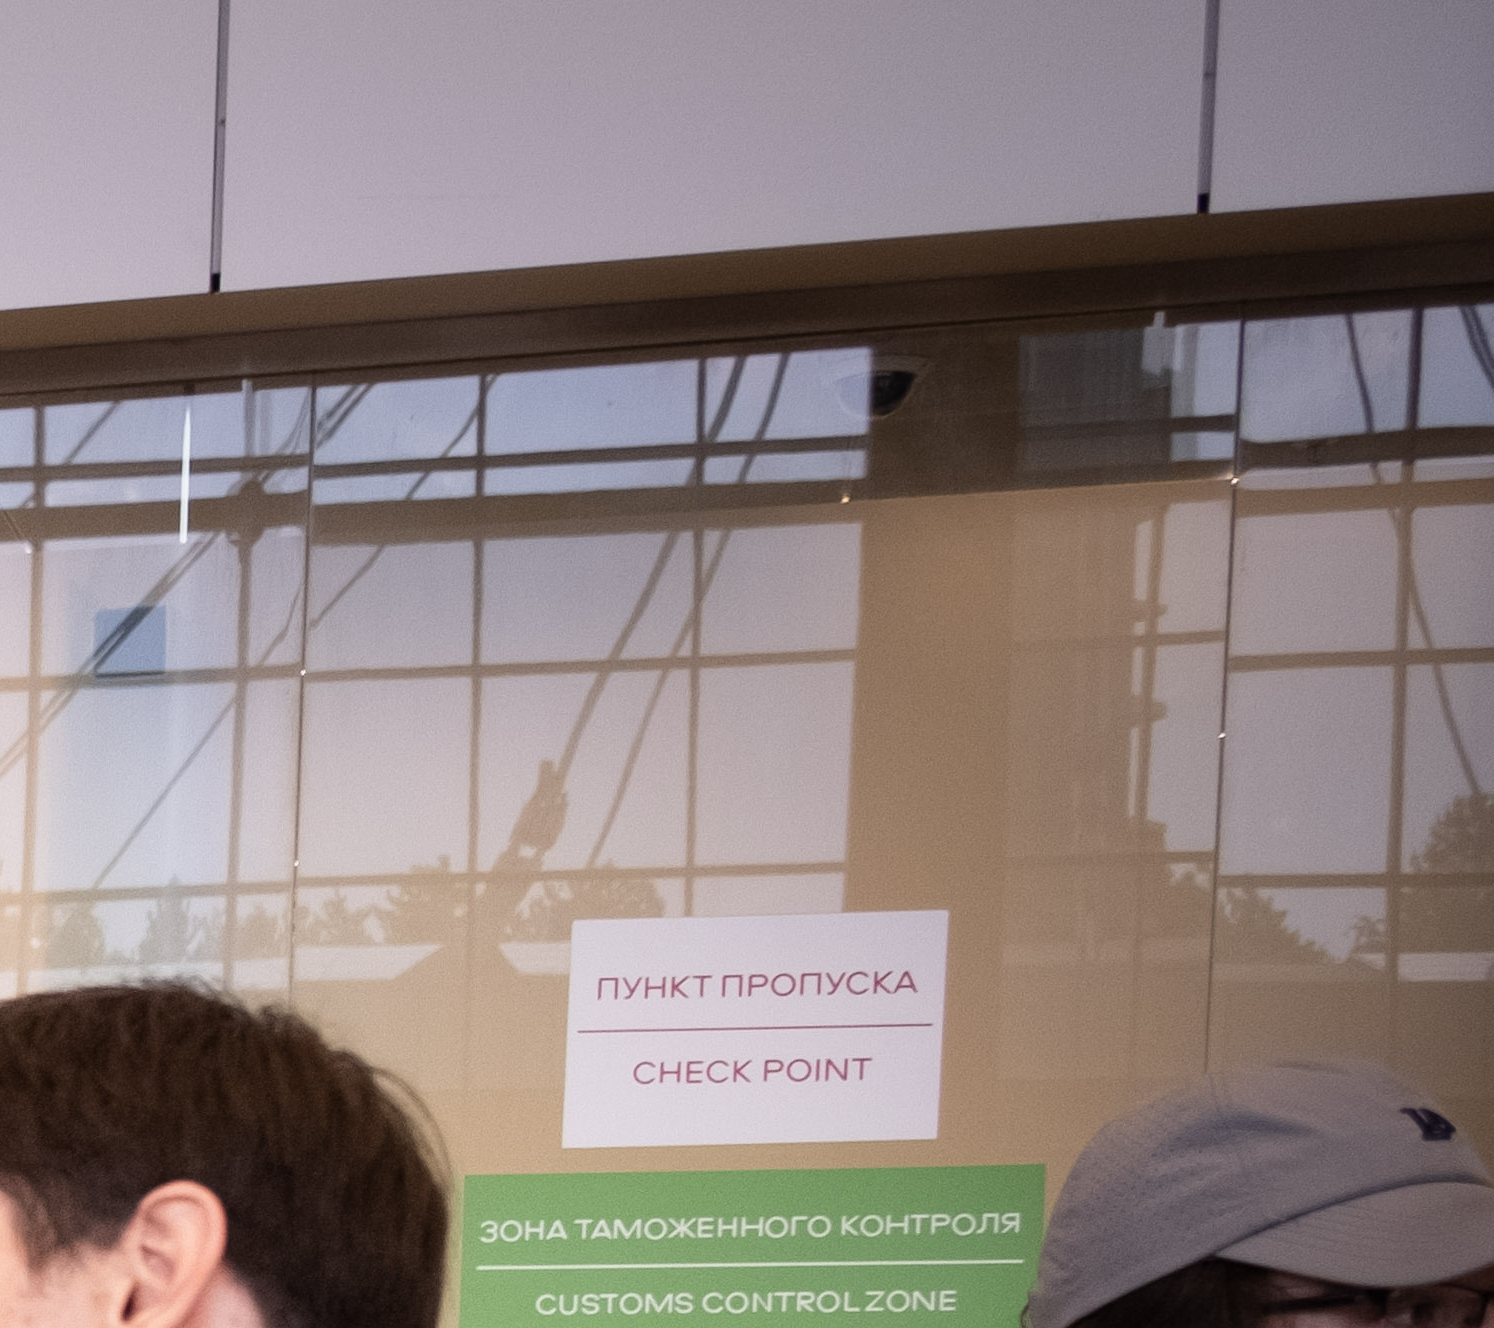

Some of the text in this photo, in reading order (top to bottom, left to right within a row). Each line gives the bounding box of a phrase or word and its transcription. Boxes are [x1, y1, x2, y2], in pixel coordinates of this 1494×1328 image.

[597, 970, 919, 1000] ПУНКТ ПРОПУСКА
[632, 1057, 873, 1085] CHECK POINT
[479, 1211, 1022, 1243] ЗОНА ТАМОЖЕННОГО КОНТРОЛЯ
[534, 1288, 958, 1316] CUSTOMS CONTROL ZONE
